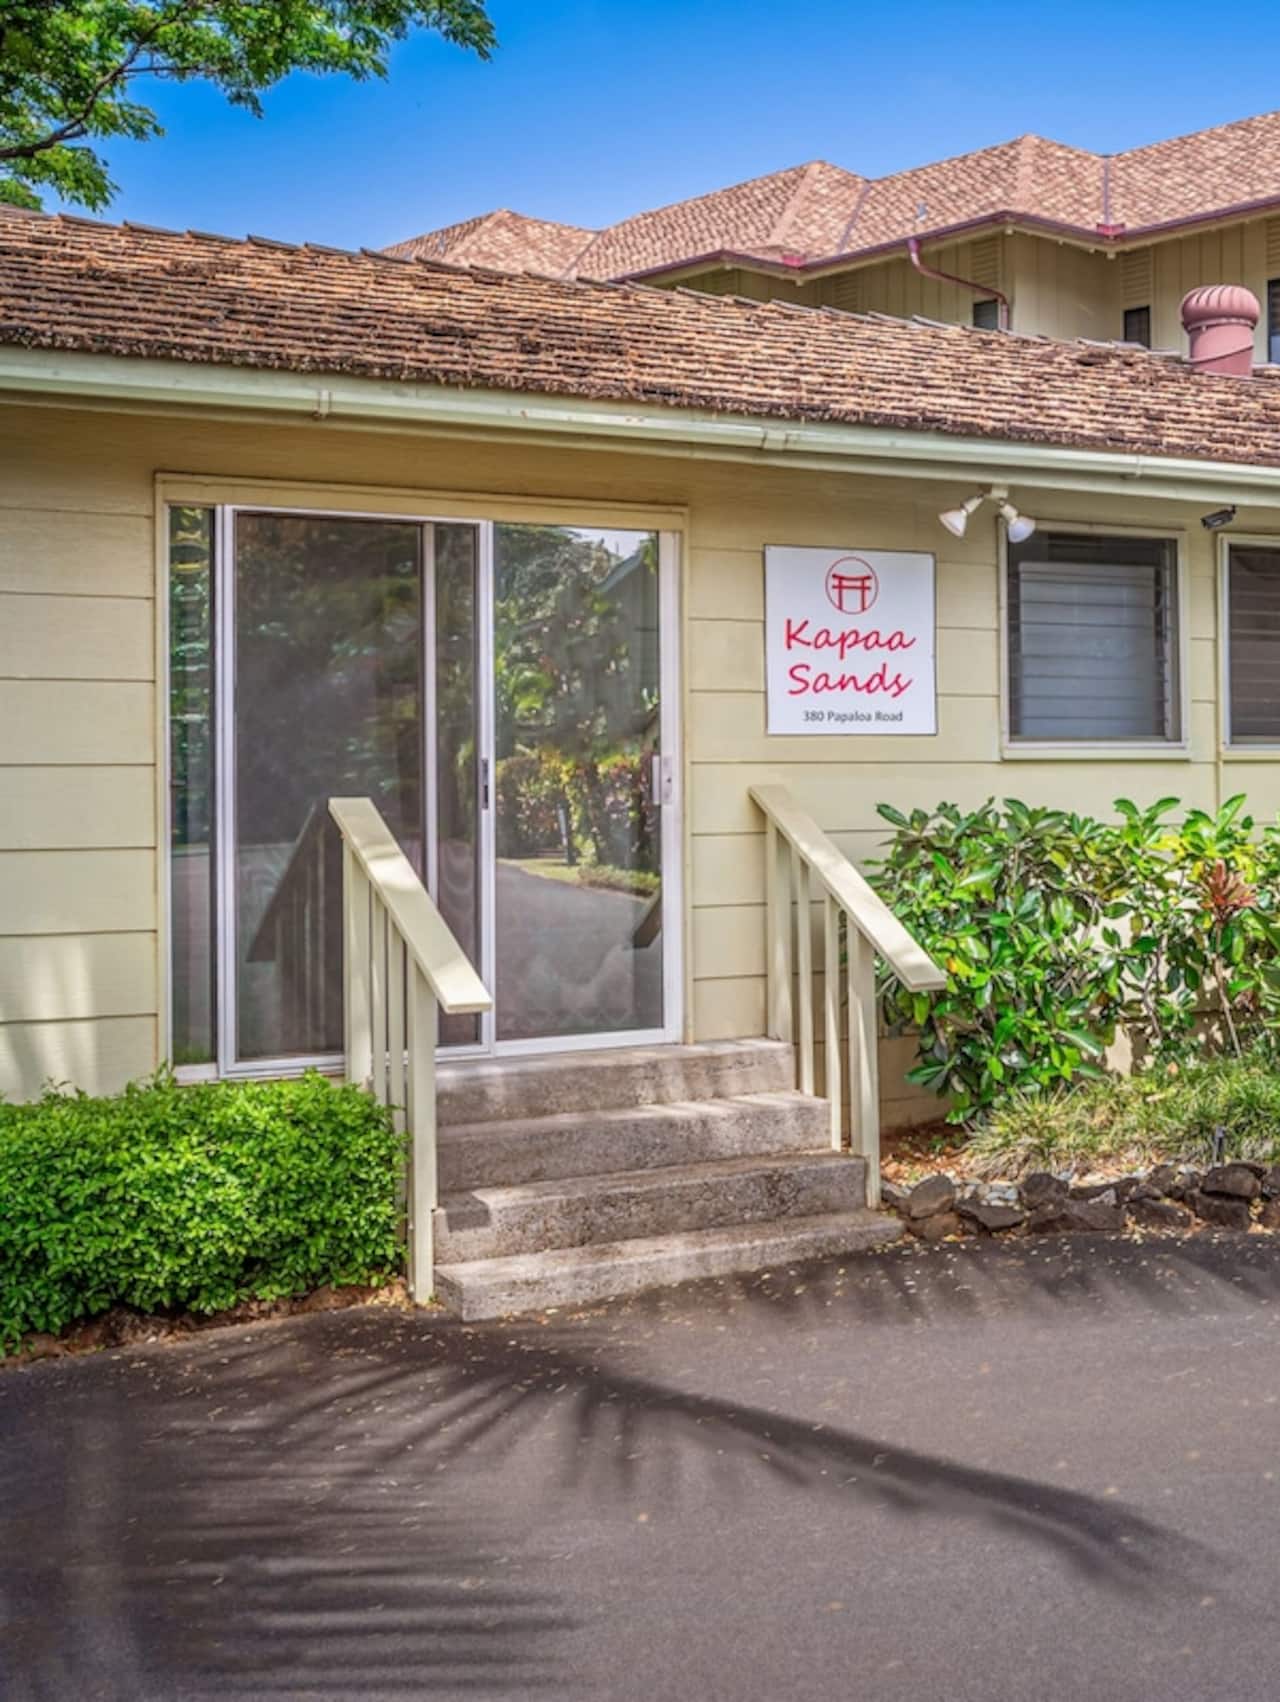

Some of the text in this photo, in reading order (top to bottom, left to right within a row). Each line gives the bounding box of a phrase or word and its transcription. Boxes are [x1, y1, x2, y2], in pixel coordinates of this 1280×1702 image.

[785, 618, 917, 661] Kapaa
[787, 662, 913, 698] Sands
[803, 710, 903, 723] 380 Papaloa Road
